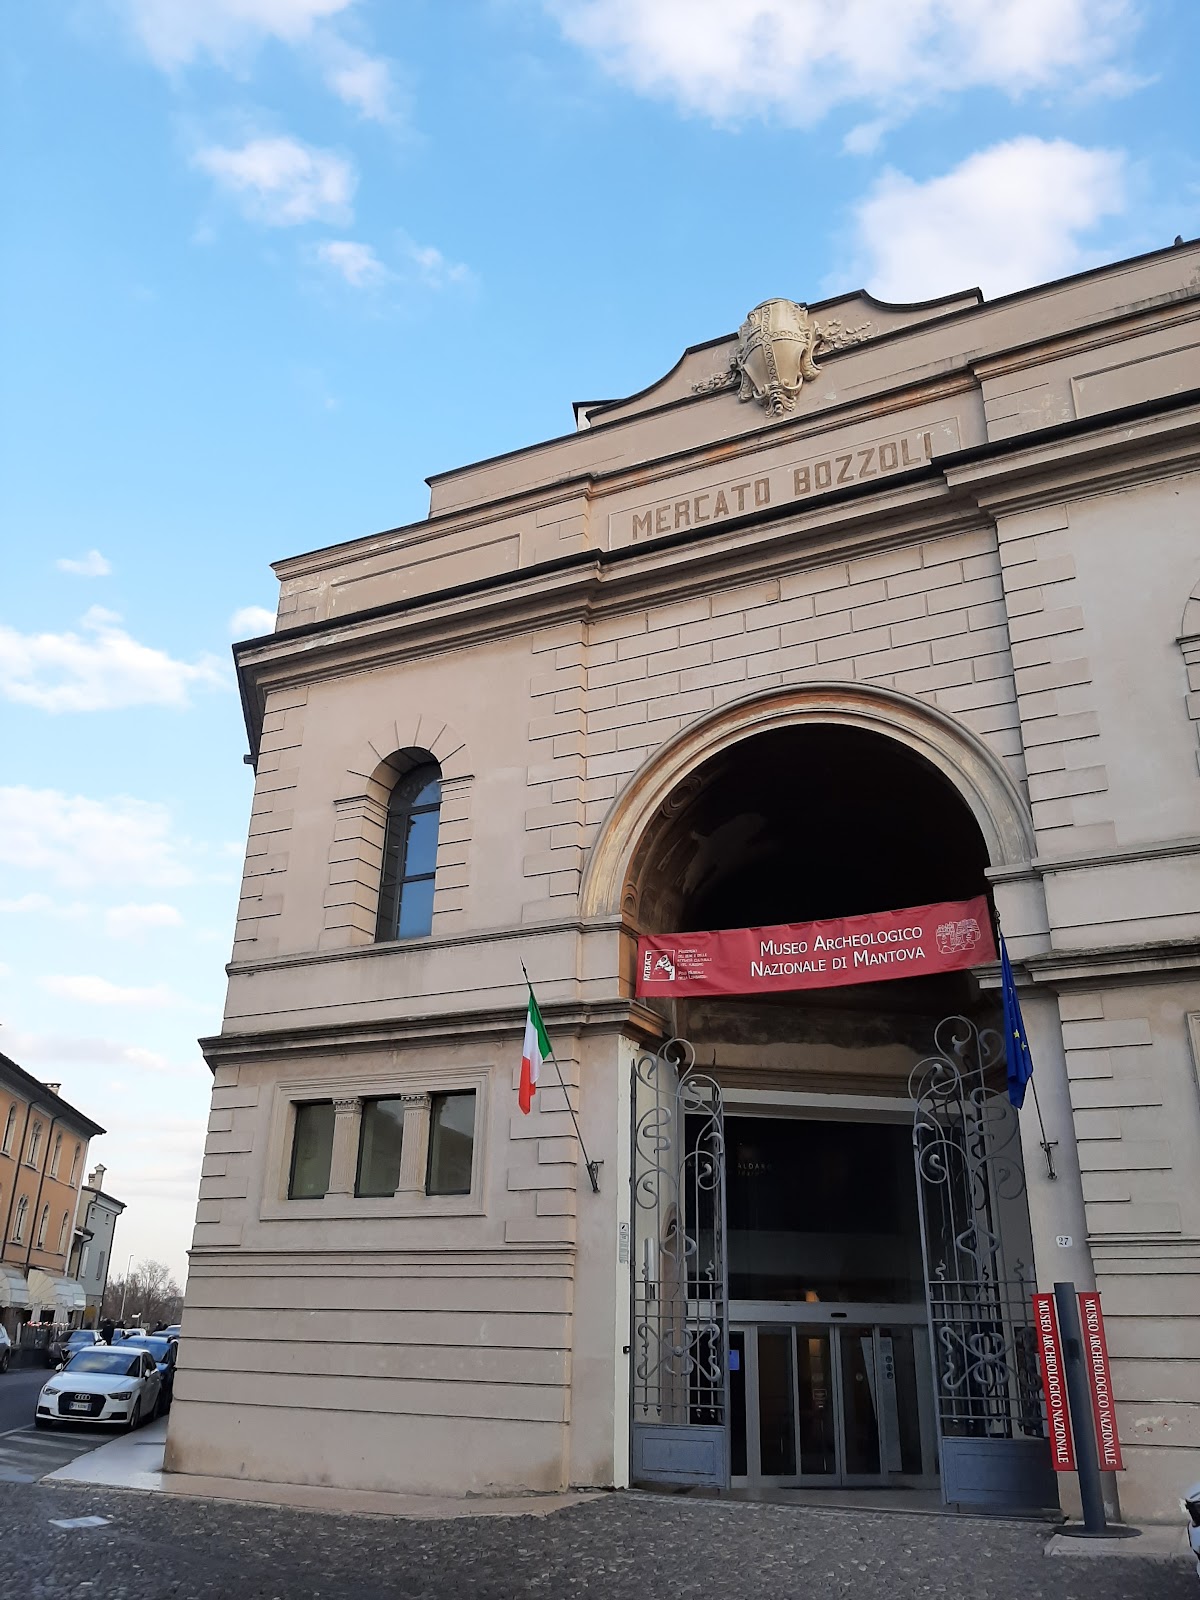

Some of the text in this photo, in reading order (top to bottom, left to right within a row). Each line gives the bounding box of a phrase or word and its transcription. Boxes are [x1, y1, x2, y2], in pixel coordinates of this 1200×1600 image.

[632, 432, 933, 540] MERCATO BOZZOLI
[751, 946, 926, 977] NAZIONALE DI MANTOVA
[760, 926, 923, 957] MUSEO ARCHEOLOGICO
[1058, 1237, 1069, 1246] 27
[1037, 1300, 1069, 1463] MUSEO ARCHEOLOGICO NAZIONALE
[1084, 1299, 1116, 1465] MUSEO ARCHEOLOGICO NAZIONALE
